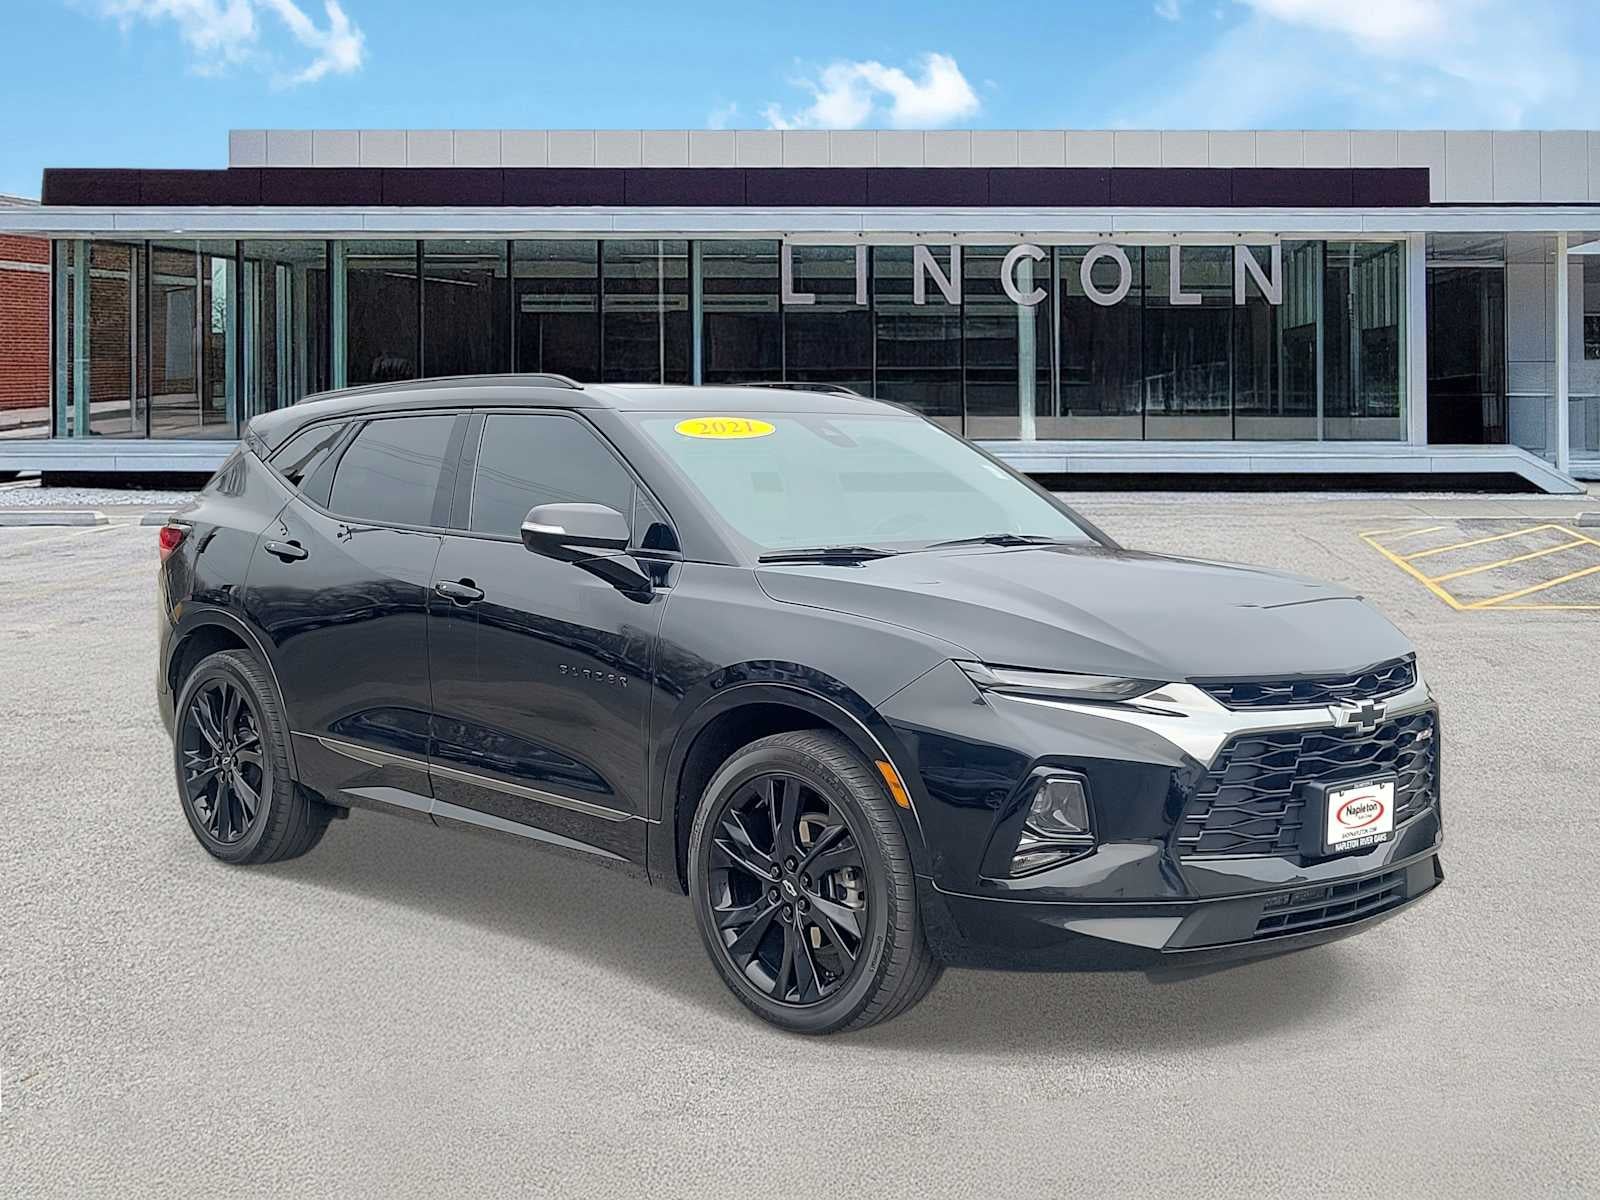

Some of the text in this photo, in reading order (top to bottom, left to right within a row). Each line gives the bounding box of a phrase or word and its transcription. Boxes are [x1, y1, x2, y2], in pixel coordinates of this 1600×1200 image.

[781, 243, 1283, 306] LINCOLN
[695, 420, 753, 435] 2021
[1346, 803, 1378, 816] Napleton
[1335, 840, 1359, 852] NAPLETON
